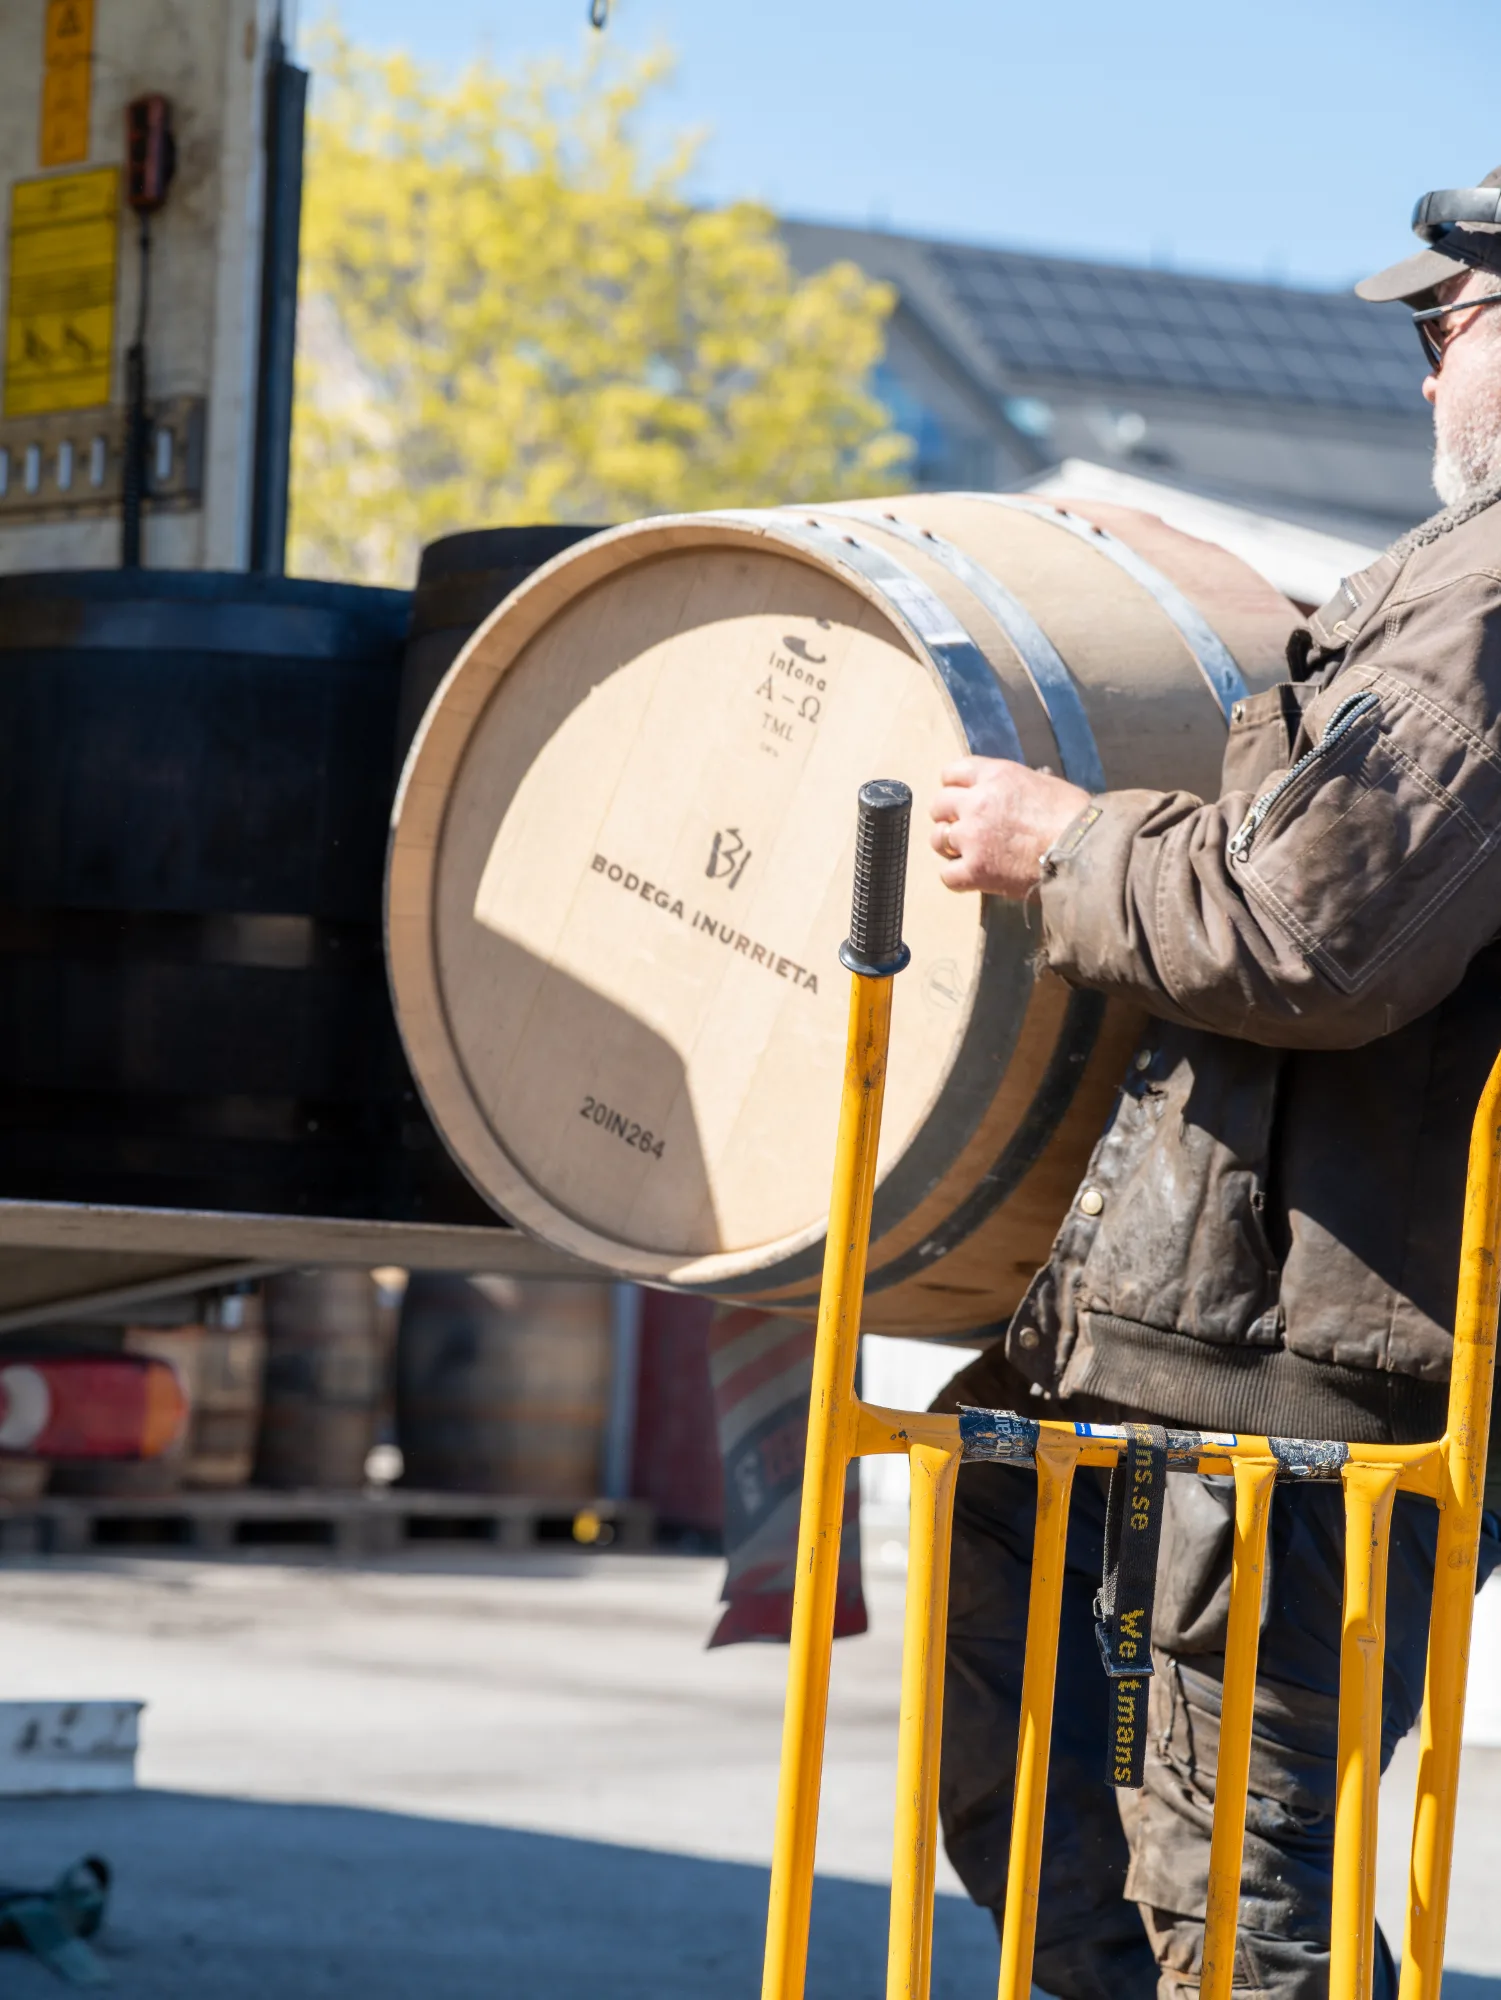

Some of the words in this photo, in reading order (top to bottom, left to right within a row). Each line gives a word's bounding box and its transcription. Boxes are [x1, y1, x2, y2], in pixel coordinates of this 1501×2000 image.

[590, 852, 684, 920] BODEGA
[690, 910, 820, 995] INURRIETA
[579, 1095, 666, 1161] 20IN264
[1113, 1608, 1145, 1782] Wetmans
